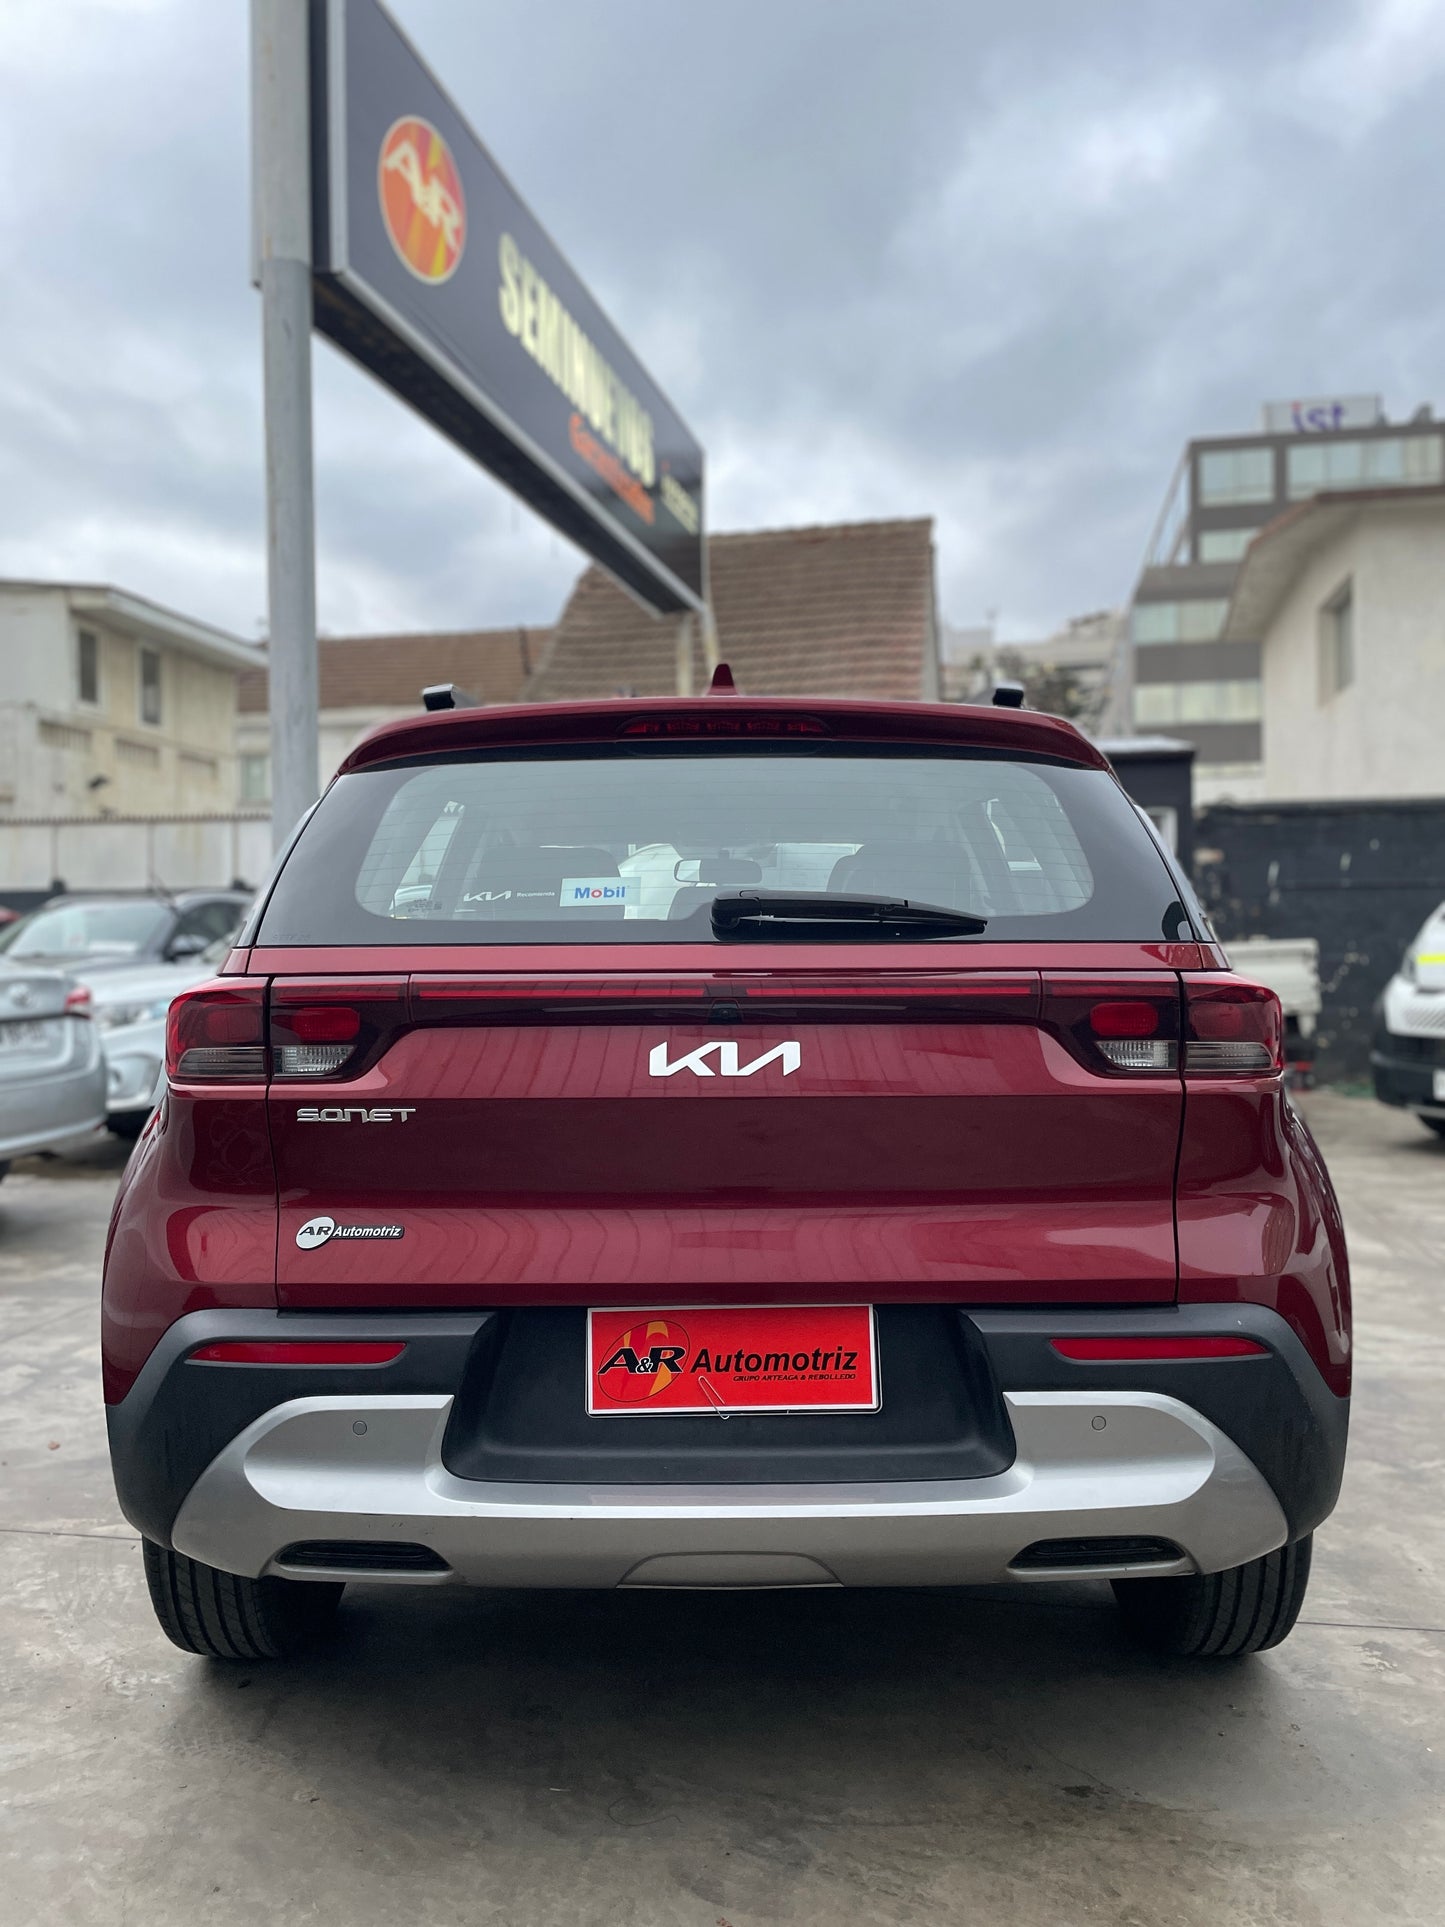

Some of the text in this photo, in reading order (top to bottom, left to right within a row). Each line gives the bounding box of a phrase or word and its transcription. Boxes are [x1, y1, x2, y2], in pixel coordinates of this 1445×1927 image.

[463, 890, 512, 902] KIA
[574, 886, 625, 899] Mobil
[649, 1041, 801, 1077] KIA
[299, 1225, 402, 1237] AR Automotriz
[597, 1345, 858, 1375] A&R Automotriz
[733, 1374, 759, 1382] GRUPO
